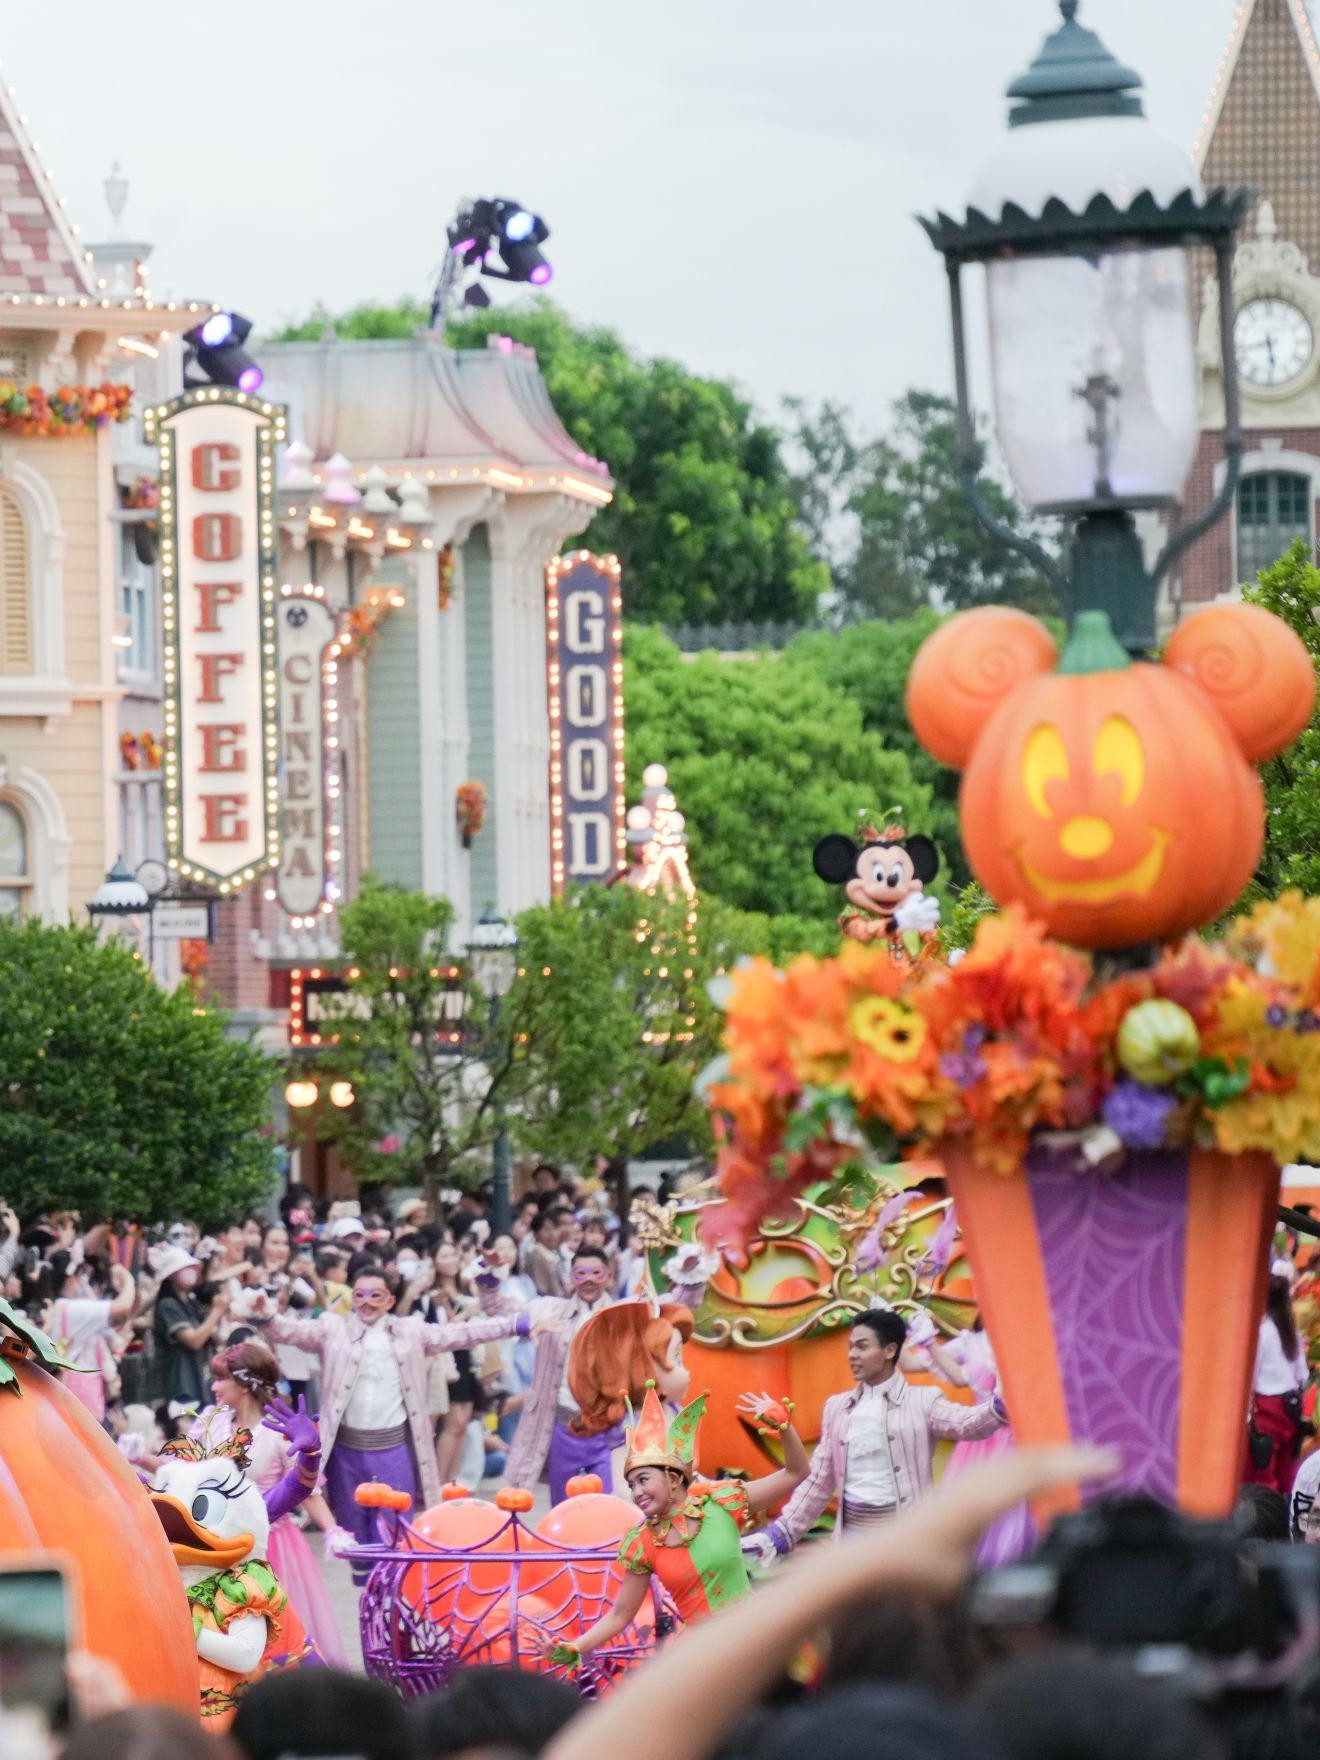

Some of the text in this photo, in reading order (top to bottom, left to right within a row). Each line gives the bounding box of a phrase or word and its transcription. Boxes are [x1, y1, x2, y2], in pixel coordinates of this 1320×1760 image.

[191, 442, 248, 843] COFFEE
[284, 653, 317, 878] CINEMA
[565, 590, 611, 876] GOOD
